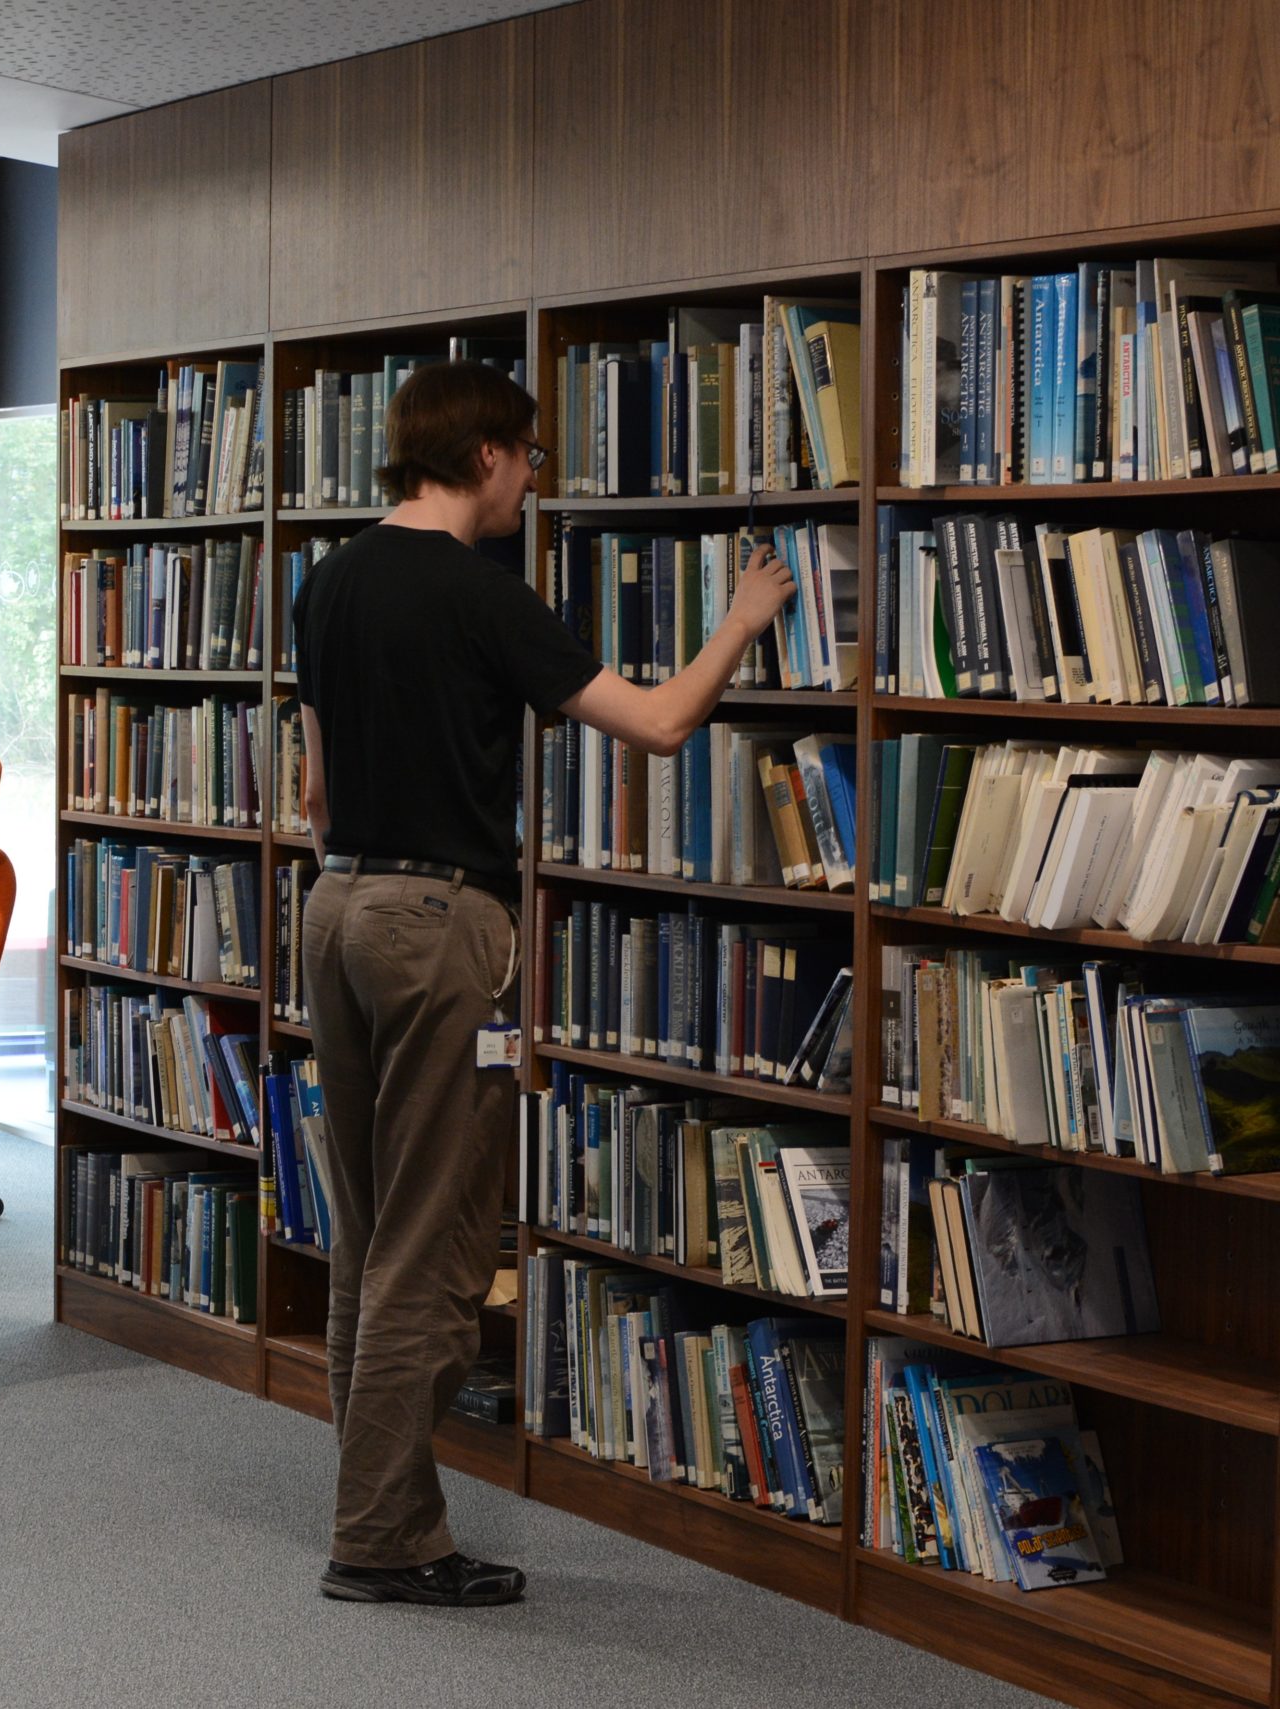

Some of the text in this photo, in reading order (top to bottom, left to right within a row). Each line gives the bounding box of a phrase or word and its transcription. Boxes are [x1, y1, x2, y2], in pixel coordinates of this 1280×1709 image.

[960, 312, 969, 420] ANTARCTIC
[968, 315, 976, 381] ENCYCLOPEDIA
[977, 310, 986, 419] ANTARCTIC
[1033, 299, 1045, 386] Antarctica
[1056, 297, 1067, 384] Antarctica
[1178, 304, 1189, 347] PINK ICE
[753, 371, 762, 399] WISE
[87, 411, 95, 507] ARCTIC AND ANTARCTIC
[753, 405, 762, 465] ADVENTURE
[946, 521, 958, 567] ANTARCTICA
[954, 585, 966, 640] INTERNATIONAL
[968, 523, 979, 568] ANTARCTICA
[975, 586, 987, 641] INTERNATIONAL
[1203, 545, 1217, 603] ANTARCTICA
[659, 761, 671, 839] AWSON
[591, 946, 599, 990] ANTARCTIC
[623, 940, 631, 992] Shackleton
[671, 920, 684, 1005] SHACKLETON
[760, 1355, 785, 1442] Antarctica
